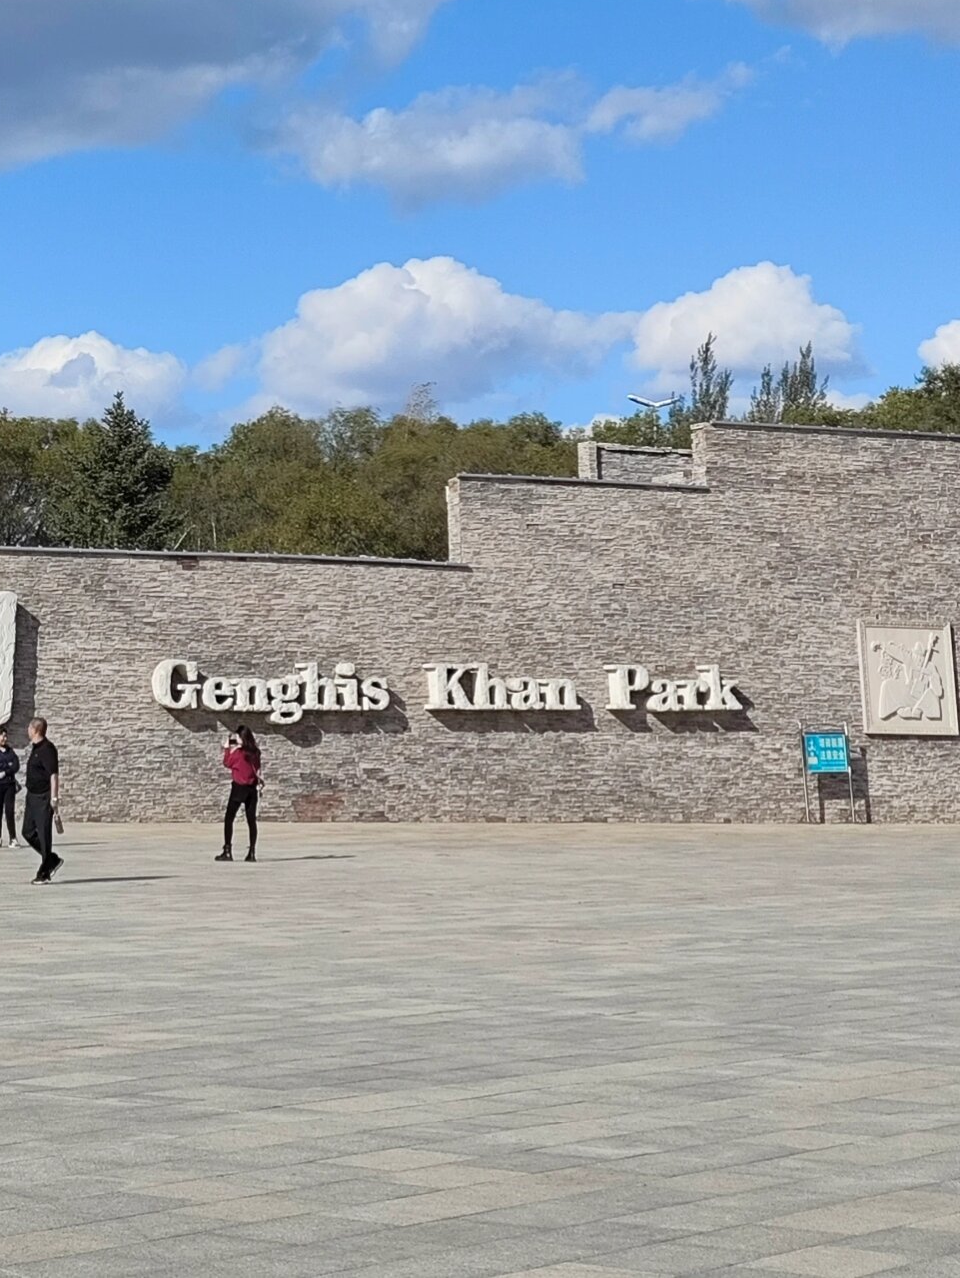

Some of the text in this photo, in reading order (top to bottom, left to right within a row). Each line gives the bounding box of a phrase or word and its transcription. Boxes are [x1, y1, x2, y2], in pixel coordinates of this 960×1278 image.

[151, 658, 743, 724] Genghis Khan Park
